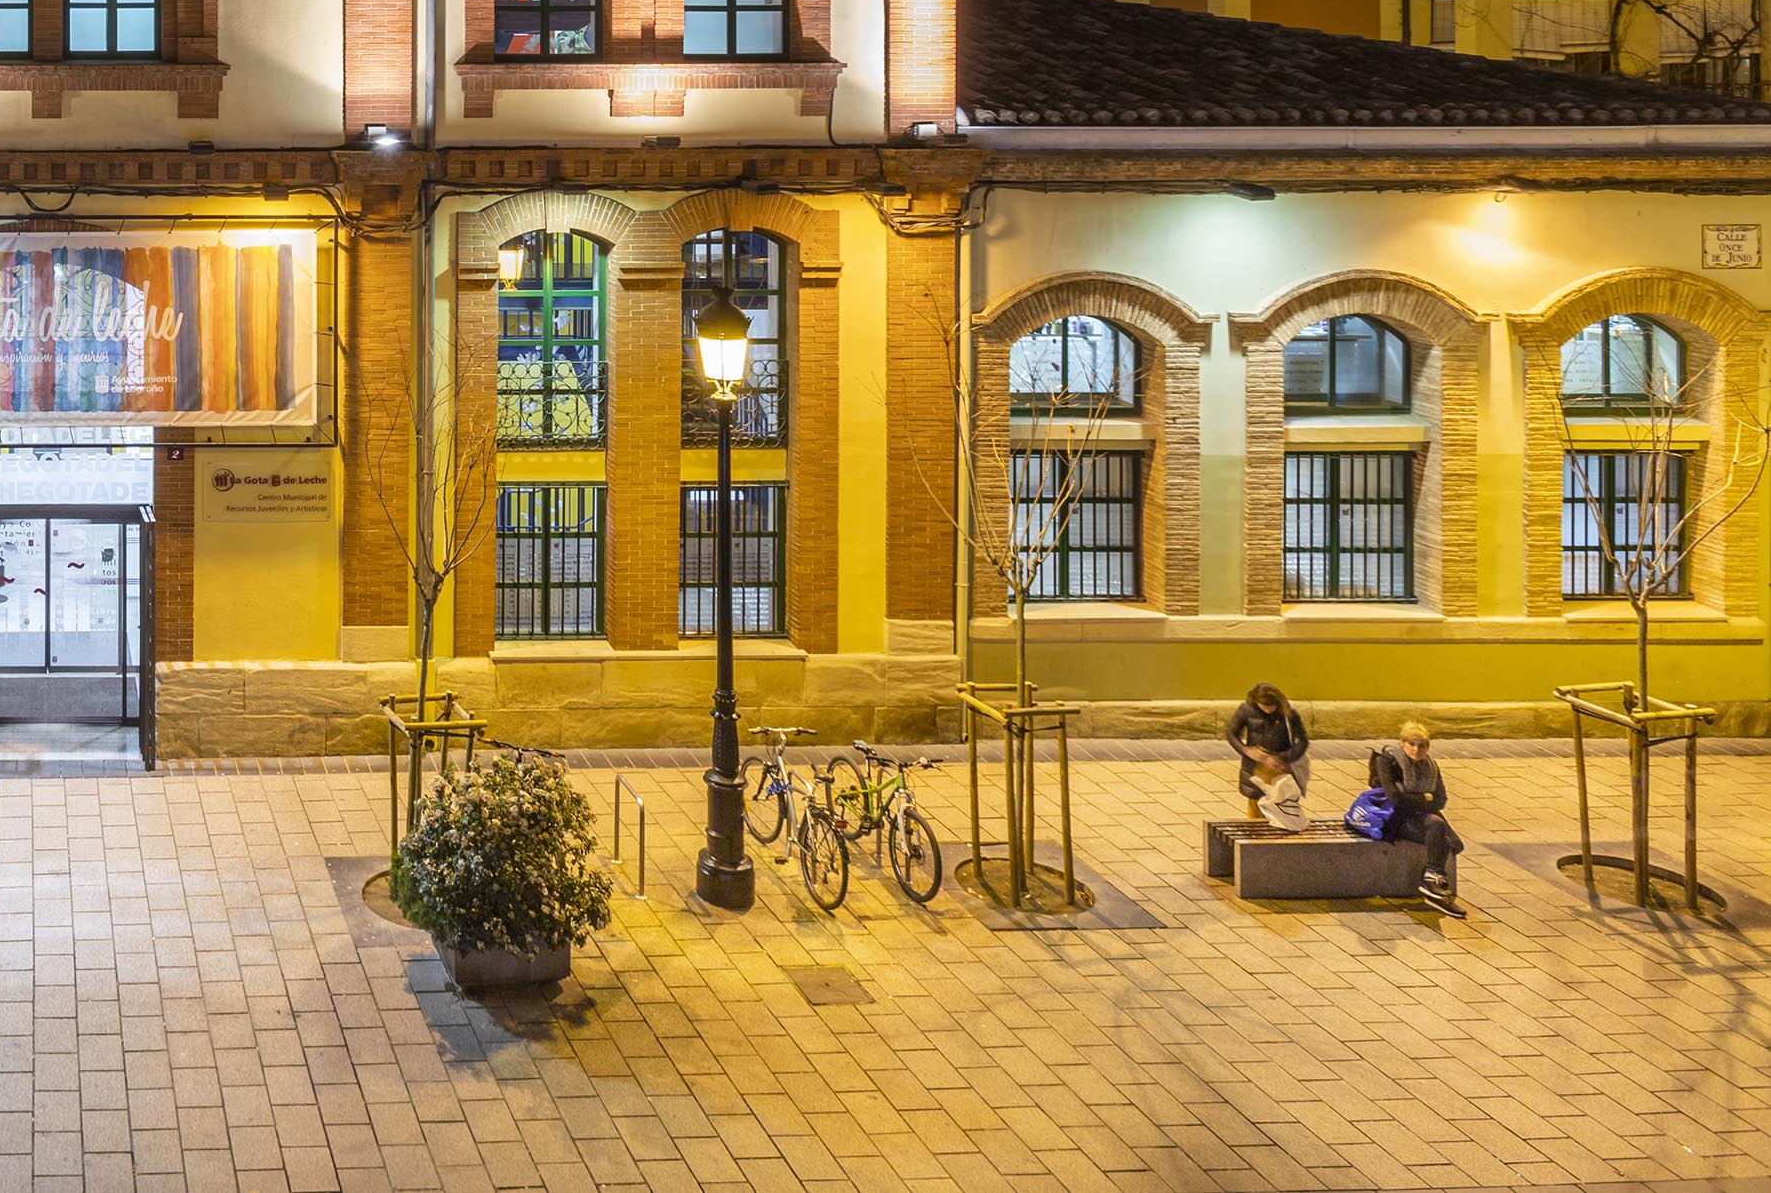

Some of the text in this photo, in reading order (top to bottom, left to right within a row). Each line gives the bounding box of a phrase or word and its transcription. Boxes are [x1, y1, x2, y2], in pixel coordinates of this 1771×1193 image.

[39, 281, 80, 343] de
[92, 281, 184, 343] lehe
[75, 351, 110, 363] ecursos
[111, 375, 178, 386] Ayumiento
[171, 450, 180, 459] 2
[244, 476, 268, 485] Gota
[283, 476, 296, 485] de
[299, 476, 327, 485] Leche
[283, 494, 317, 503] Municipal
